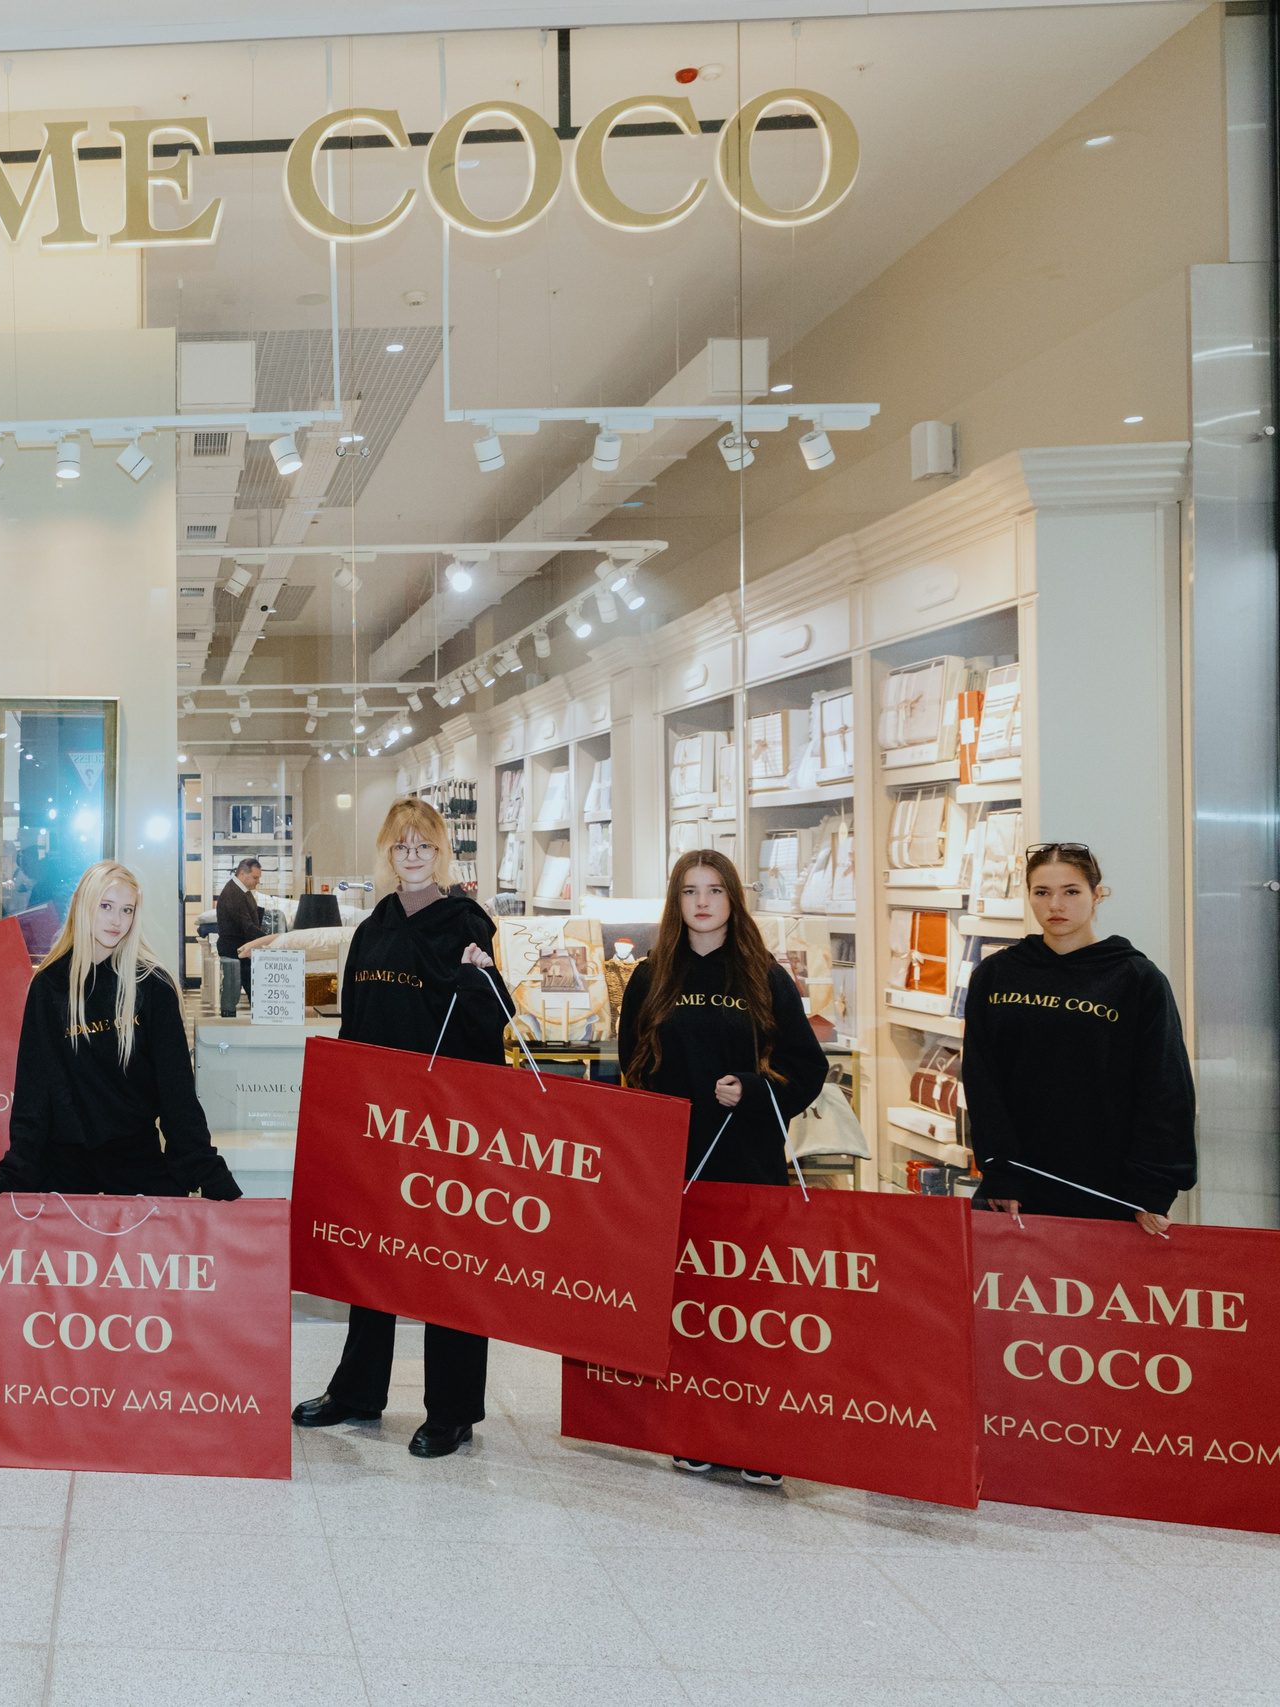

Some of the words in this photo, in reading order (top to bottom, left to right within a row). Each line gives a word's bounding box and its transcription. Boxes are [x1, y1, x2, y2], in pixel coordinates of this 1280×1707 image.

[283, 87, 860, 243] COCO
[264, 973, 290, 984] -20%
[265, 962, 293, 971] СКИДКА
[263, 1005, 289, 1016] -30%
[264, 989, 289, 1000] -25%
[988, 992, 1061, 1008] MADAME
[1065, 998, 1119, 1022] COCO
[235, 1084, 287, 1093] MADAME
[362, 1102, 602, 1184] MADAME
[400, 1172, 551, 1234] COCO
[312, 1220, 372, 1249] НЕСУ
[378, 1234, 489, 1276] КРАСОТУ
[494, 1262, 546, 1291] ДЛЯ
[551, 1276, 638, 1312] ДОМА
[674, 1237, 880, 1293] ADAME
[671, 1299, 832, 1354] COCO
[973, 1271, 1248, 1333] MADAME
[22, 1311, 173, 1353] COCO
[1003, 1339, 1193, 1395] COCO
[4, 1384, 116, 1408] КРАСОТУ
[122, 1389, 173, 1412] ДЛЯ
[179, 1392, 261, 1415] ДОМА
[656, 1372, 771, 1406] КРАСОТУ
[779, 1389, 834, 1416] ДЛЯ
[842, 1398, 937, 1431] ДОМА
[983, 1413, 1122, 1449] КРАСОТУ
[1131, 1431, 1193, 1457] ДЛЯ
[1204, 1438, 1280, 1466] ДОМ
